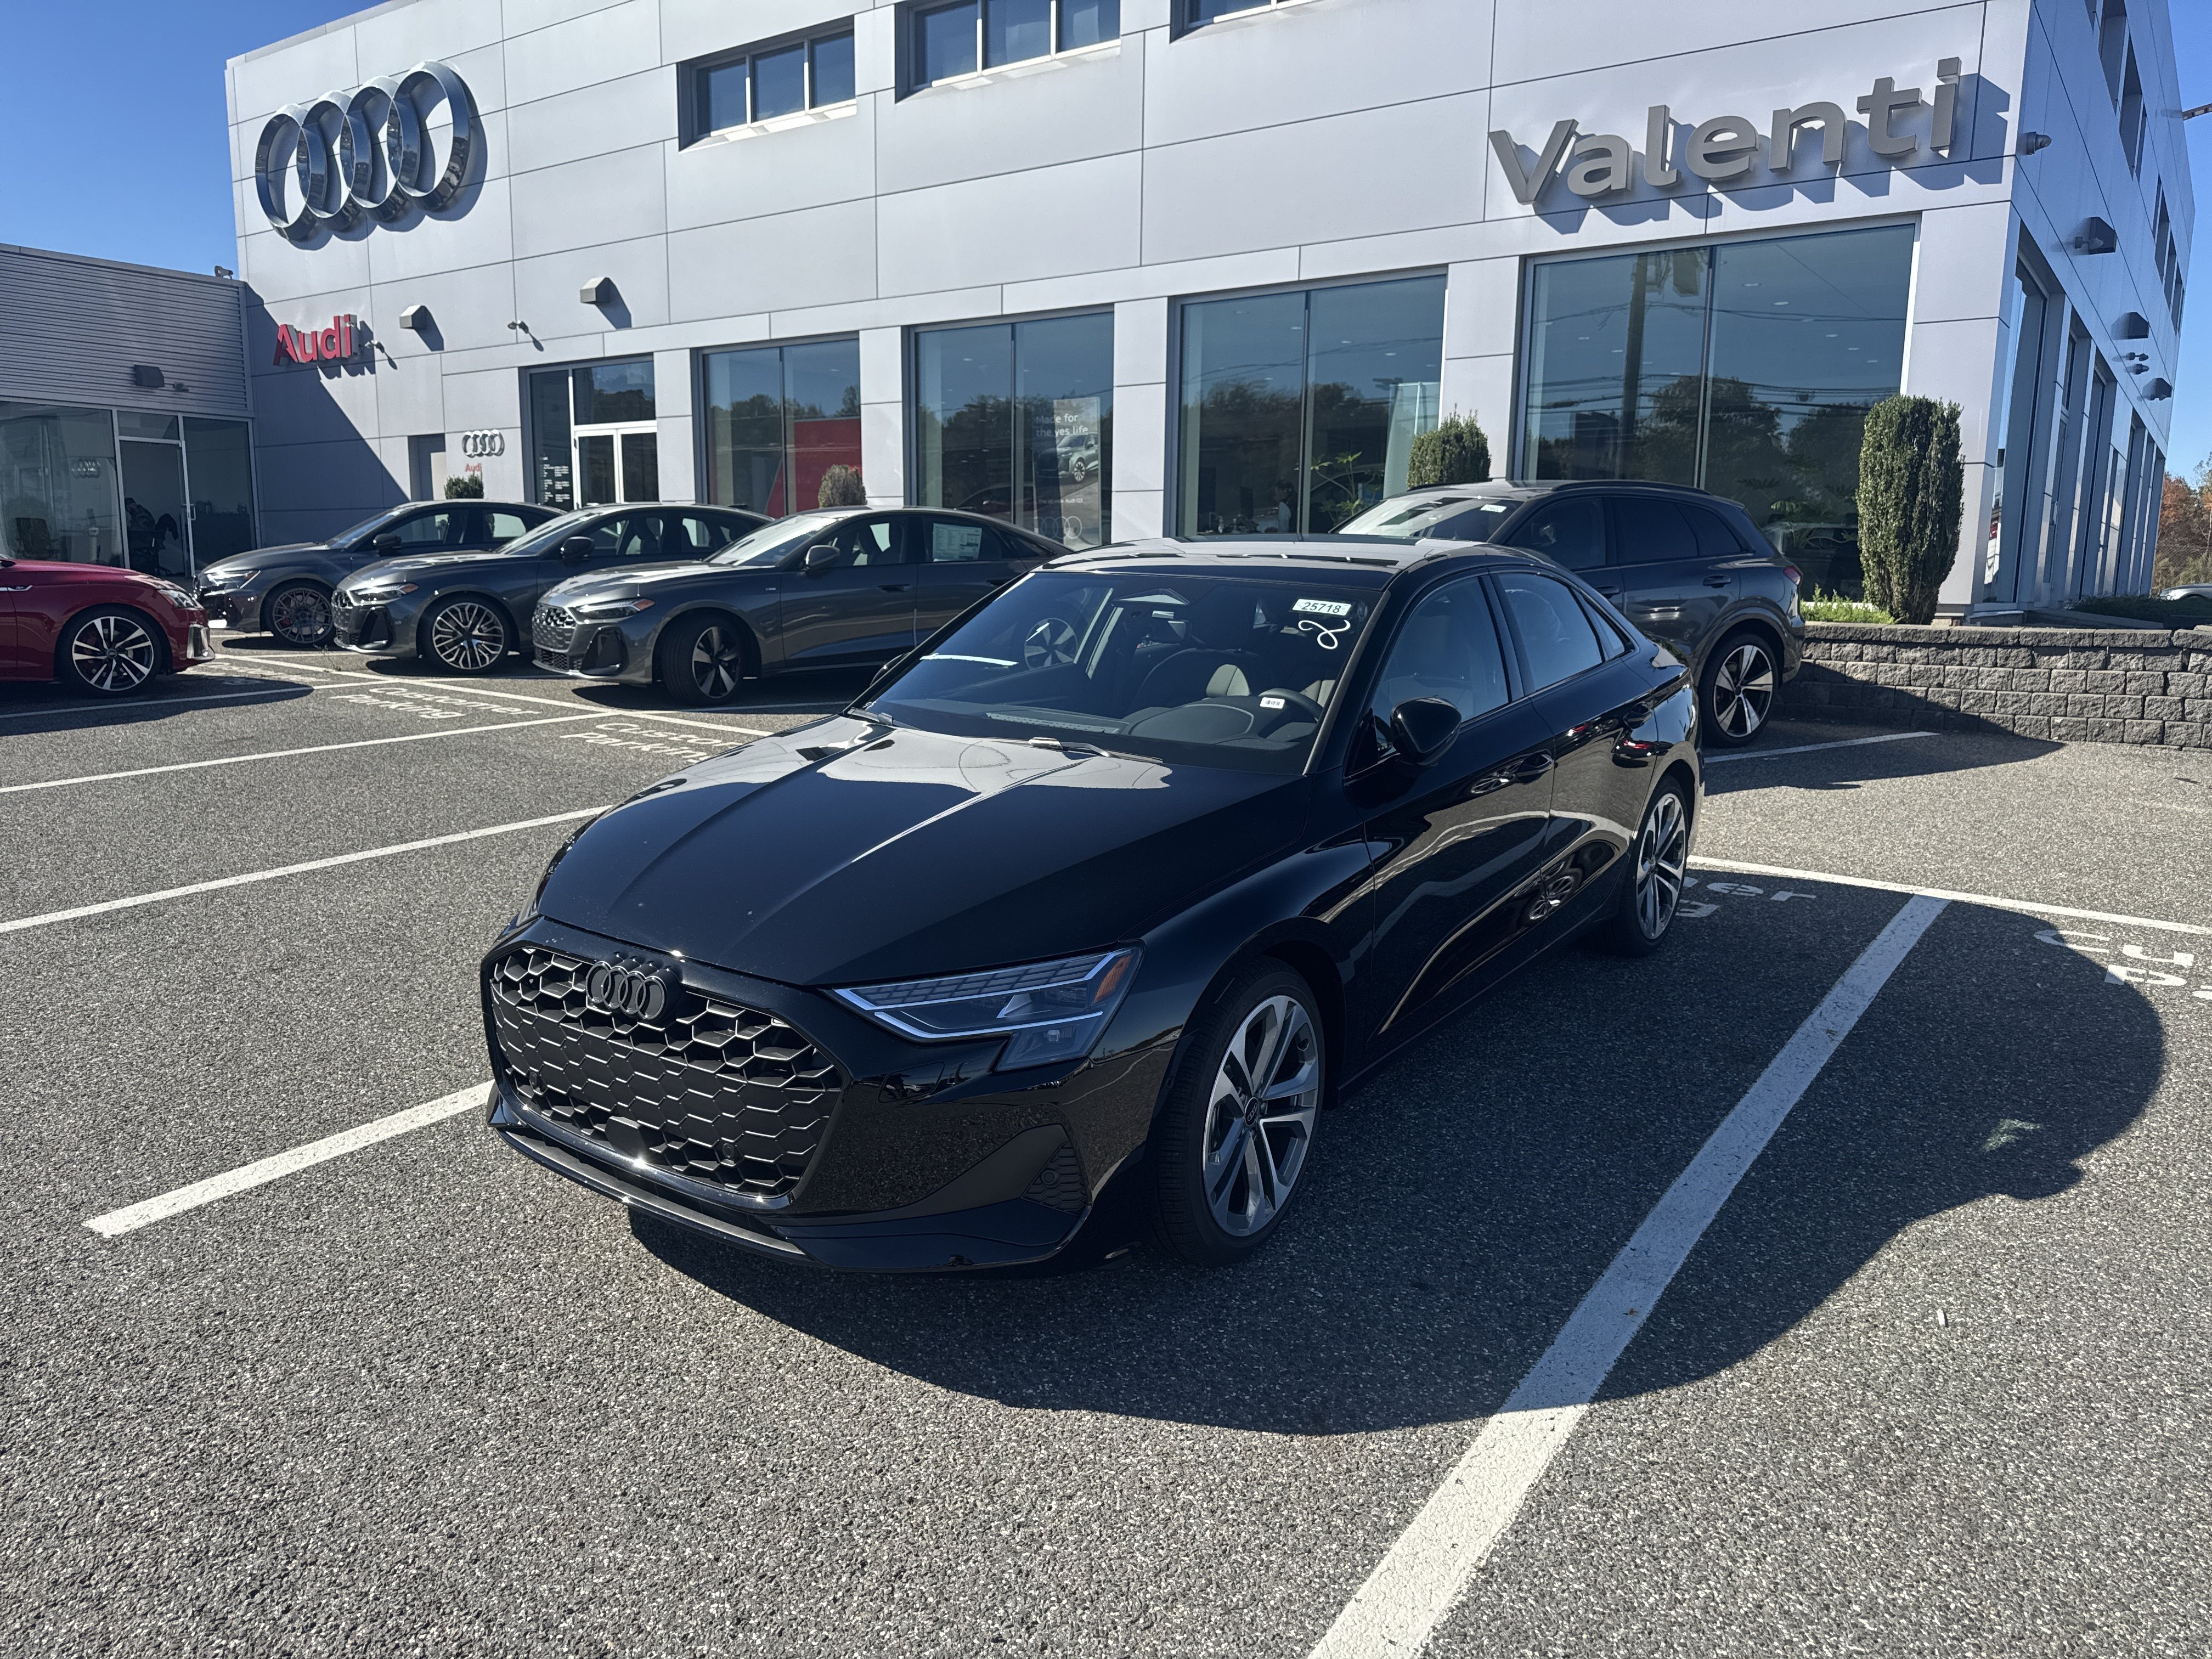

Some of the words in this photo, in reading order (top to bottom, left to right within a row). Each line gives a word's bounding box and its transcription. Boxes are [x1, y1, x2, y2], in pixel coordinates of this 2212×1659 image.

[1489, 57, 1962, 205] Valenti
[273, 314, 353, 366] Audi
[1064, 413, 1078, 422] for
[1036, 428, 1052, 437] the
[1055, 428, 1070, 438] yes
[1073, 425, 1088, 435] life
[1301, 601, 1342, 614] 25718
[369, 687, 541, 714] Customer
